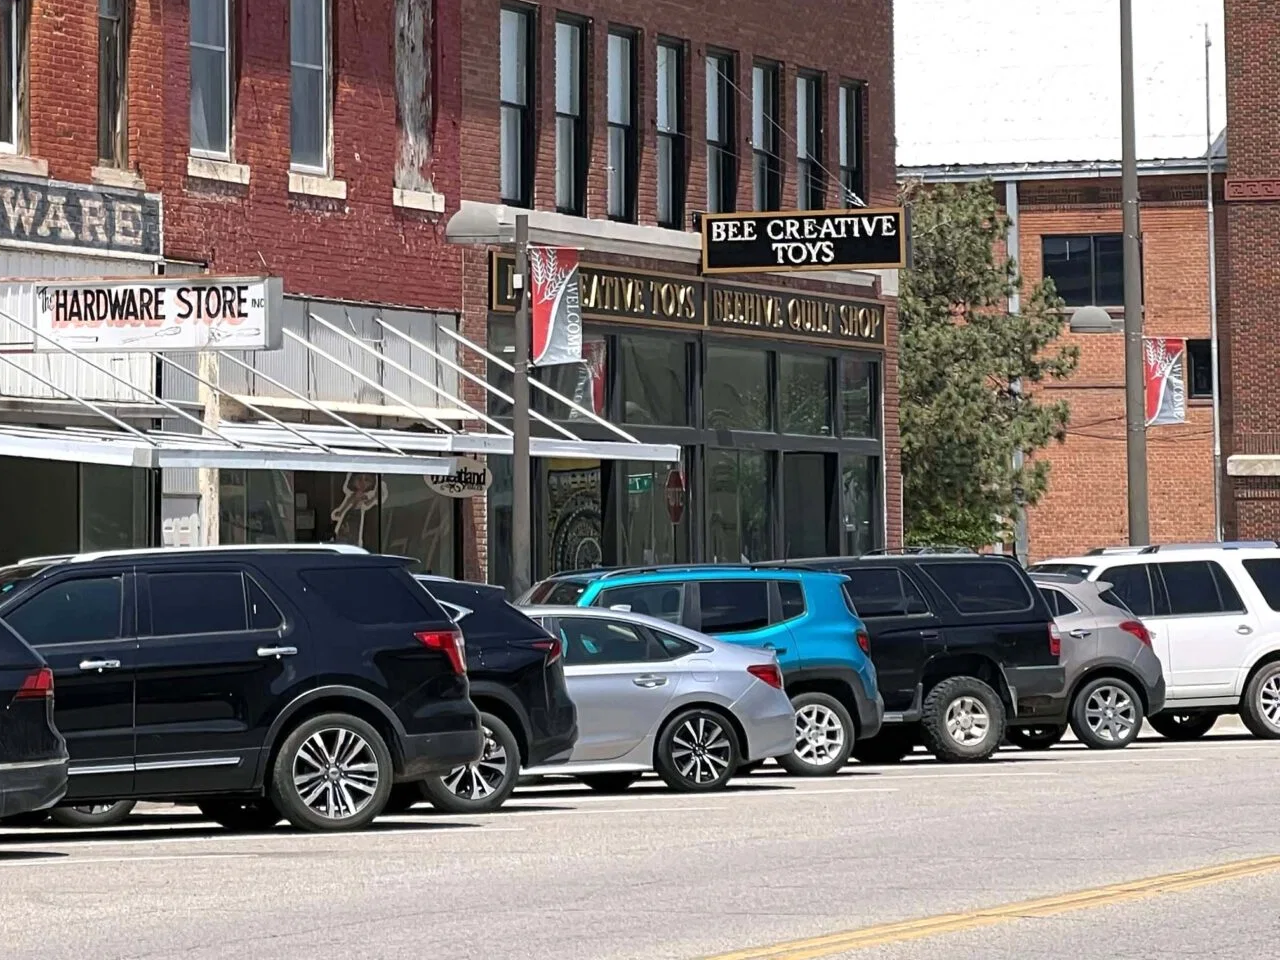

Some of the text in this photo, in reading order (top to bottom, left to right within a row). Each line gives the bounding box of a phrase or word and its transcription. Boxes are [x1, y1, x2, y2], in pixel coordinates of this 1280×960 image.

[711, 215, 897, 242] BEE CREATIVE
[771, 241, 835, 264] TOYS
[37, 285, 55, 314] The
[55, 287, 166, 322] HARDWARE
[176, 285, 249, 319] STORE
[578, 272, 645, 314] EATIVE
[650, 280, 696, 320] TOYS
[713, 289, 880, 338] BEEHIVE QUILT SHOP
[566, 280, 581, 357] WELCOME
